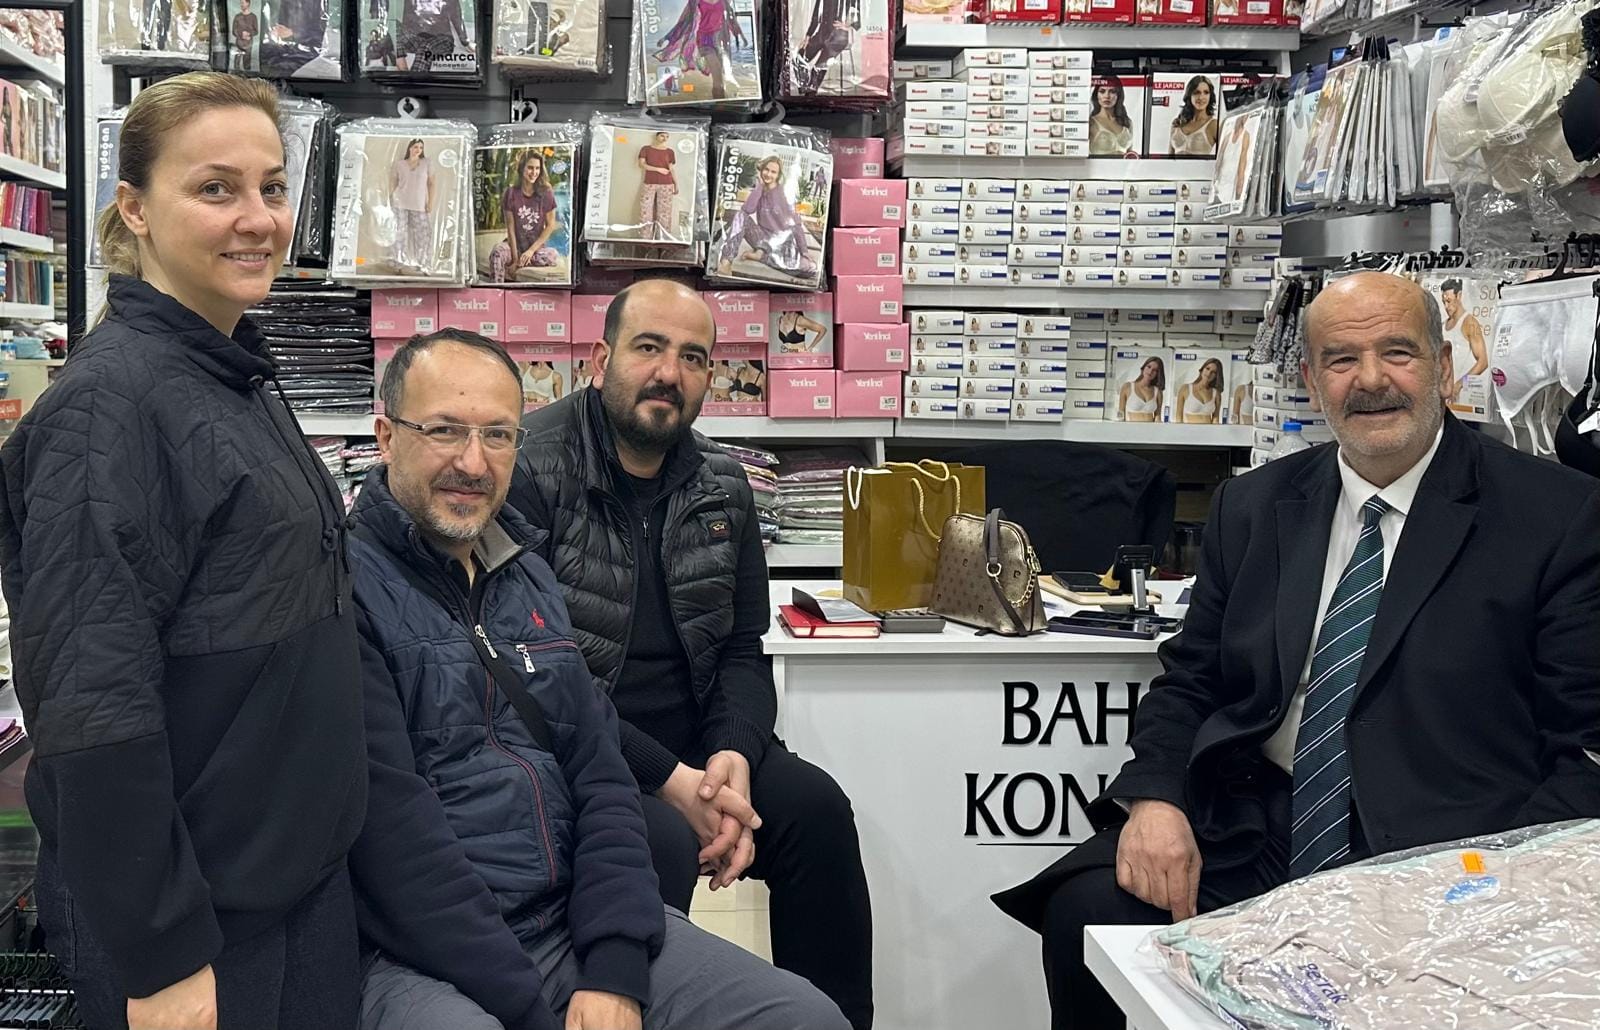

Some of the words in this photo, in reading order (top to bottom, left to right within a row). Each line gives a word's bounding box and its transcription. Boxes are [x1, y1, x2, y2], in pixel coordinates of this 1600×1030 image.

[101, 128, 114, 179] aydoğan
[591, 148, 605, 217] SEAMLIFE
[722, 147, 743, 210] aydoğan
[1002, 681, 1141, 746] BAH
